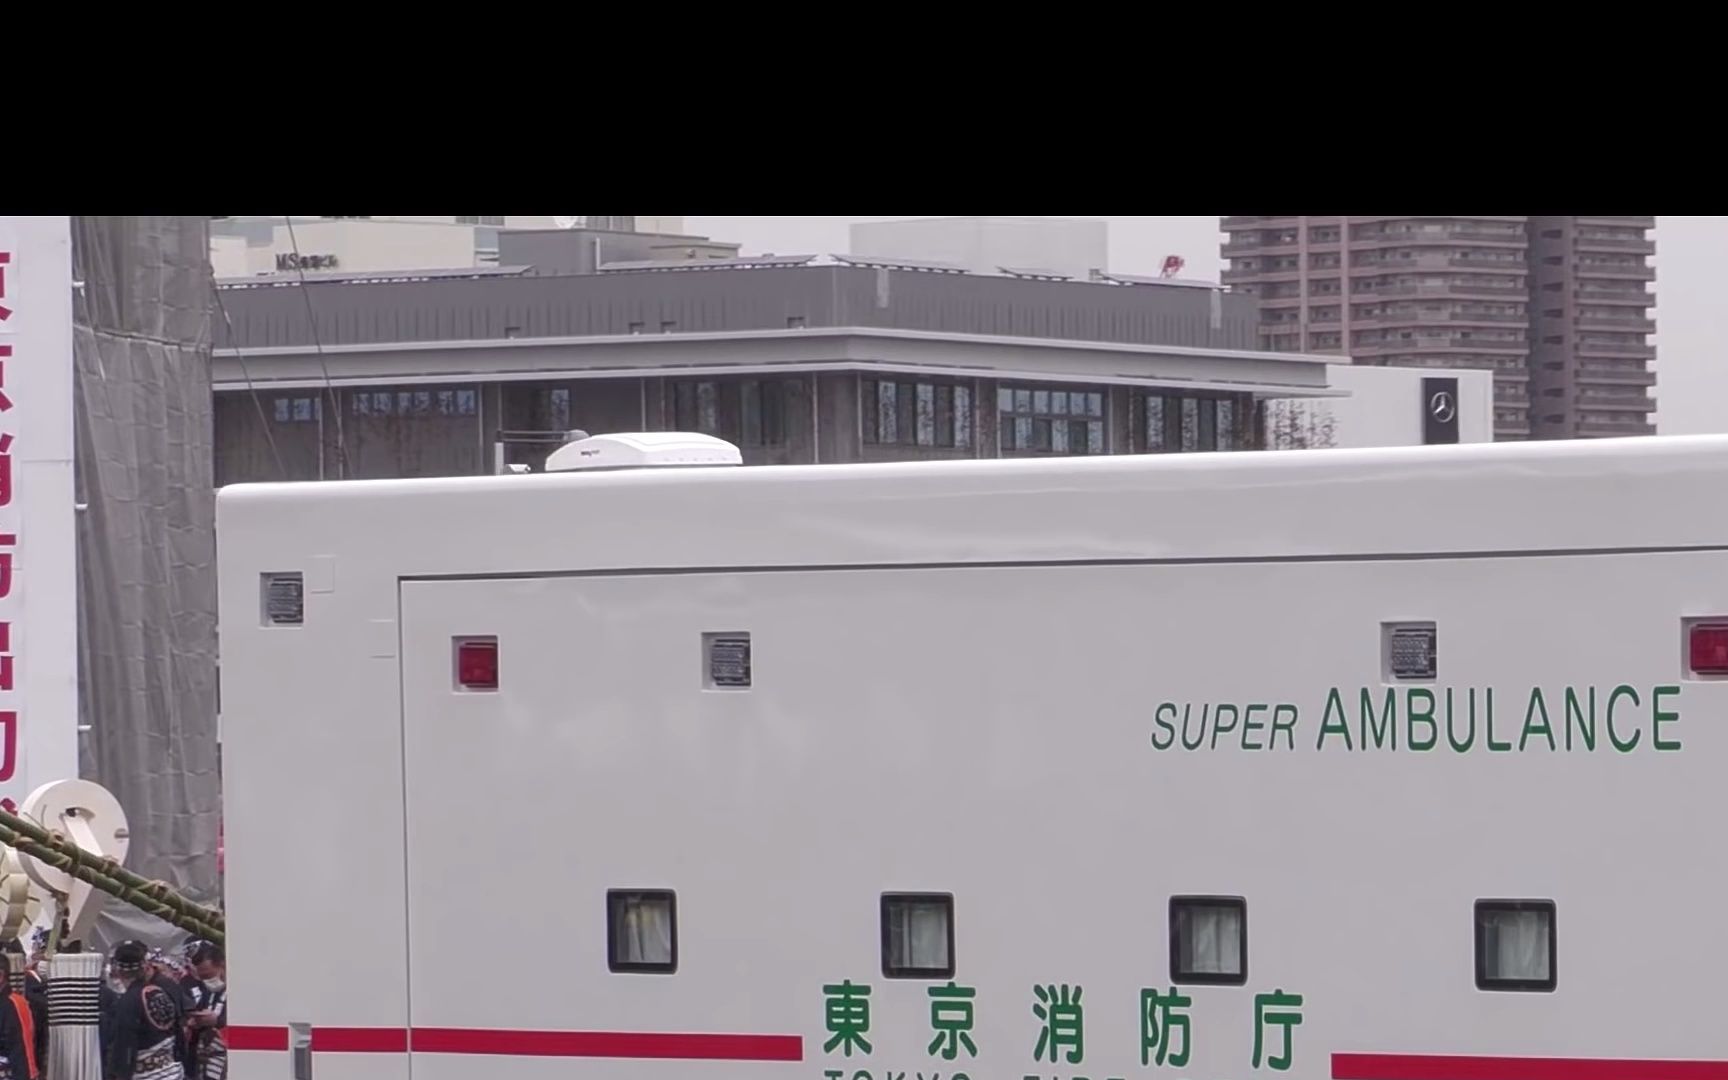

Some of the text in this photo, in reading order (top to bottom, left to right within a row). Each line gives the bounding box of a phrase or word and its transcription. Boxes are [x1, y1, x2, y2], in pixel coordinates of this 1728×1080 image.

[1151, 684, 1683, 754] SUPER AMBULANCE
[822, 979, 1305, 1071] 東京消防庁
